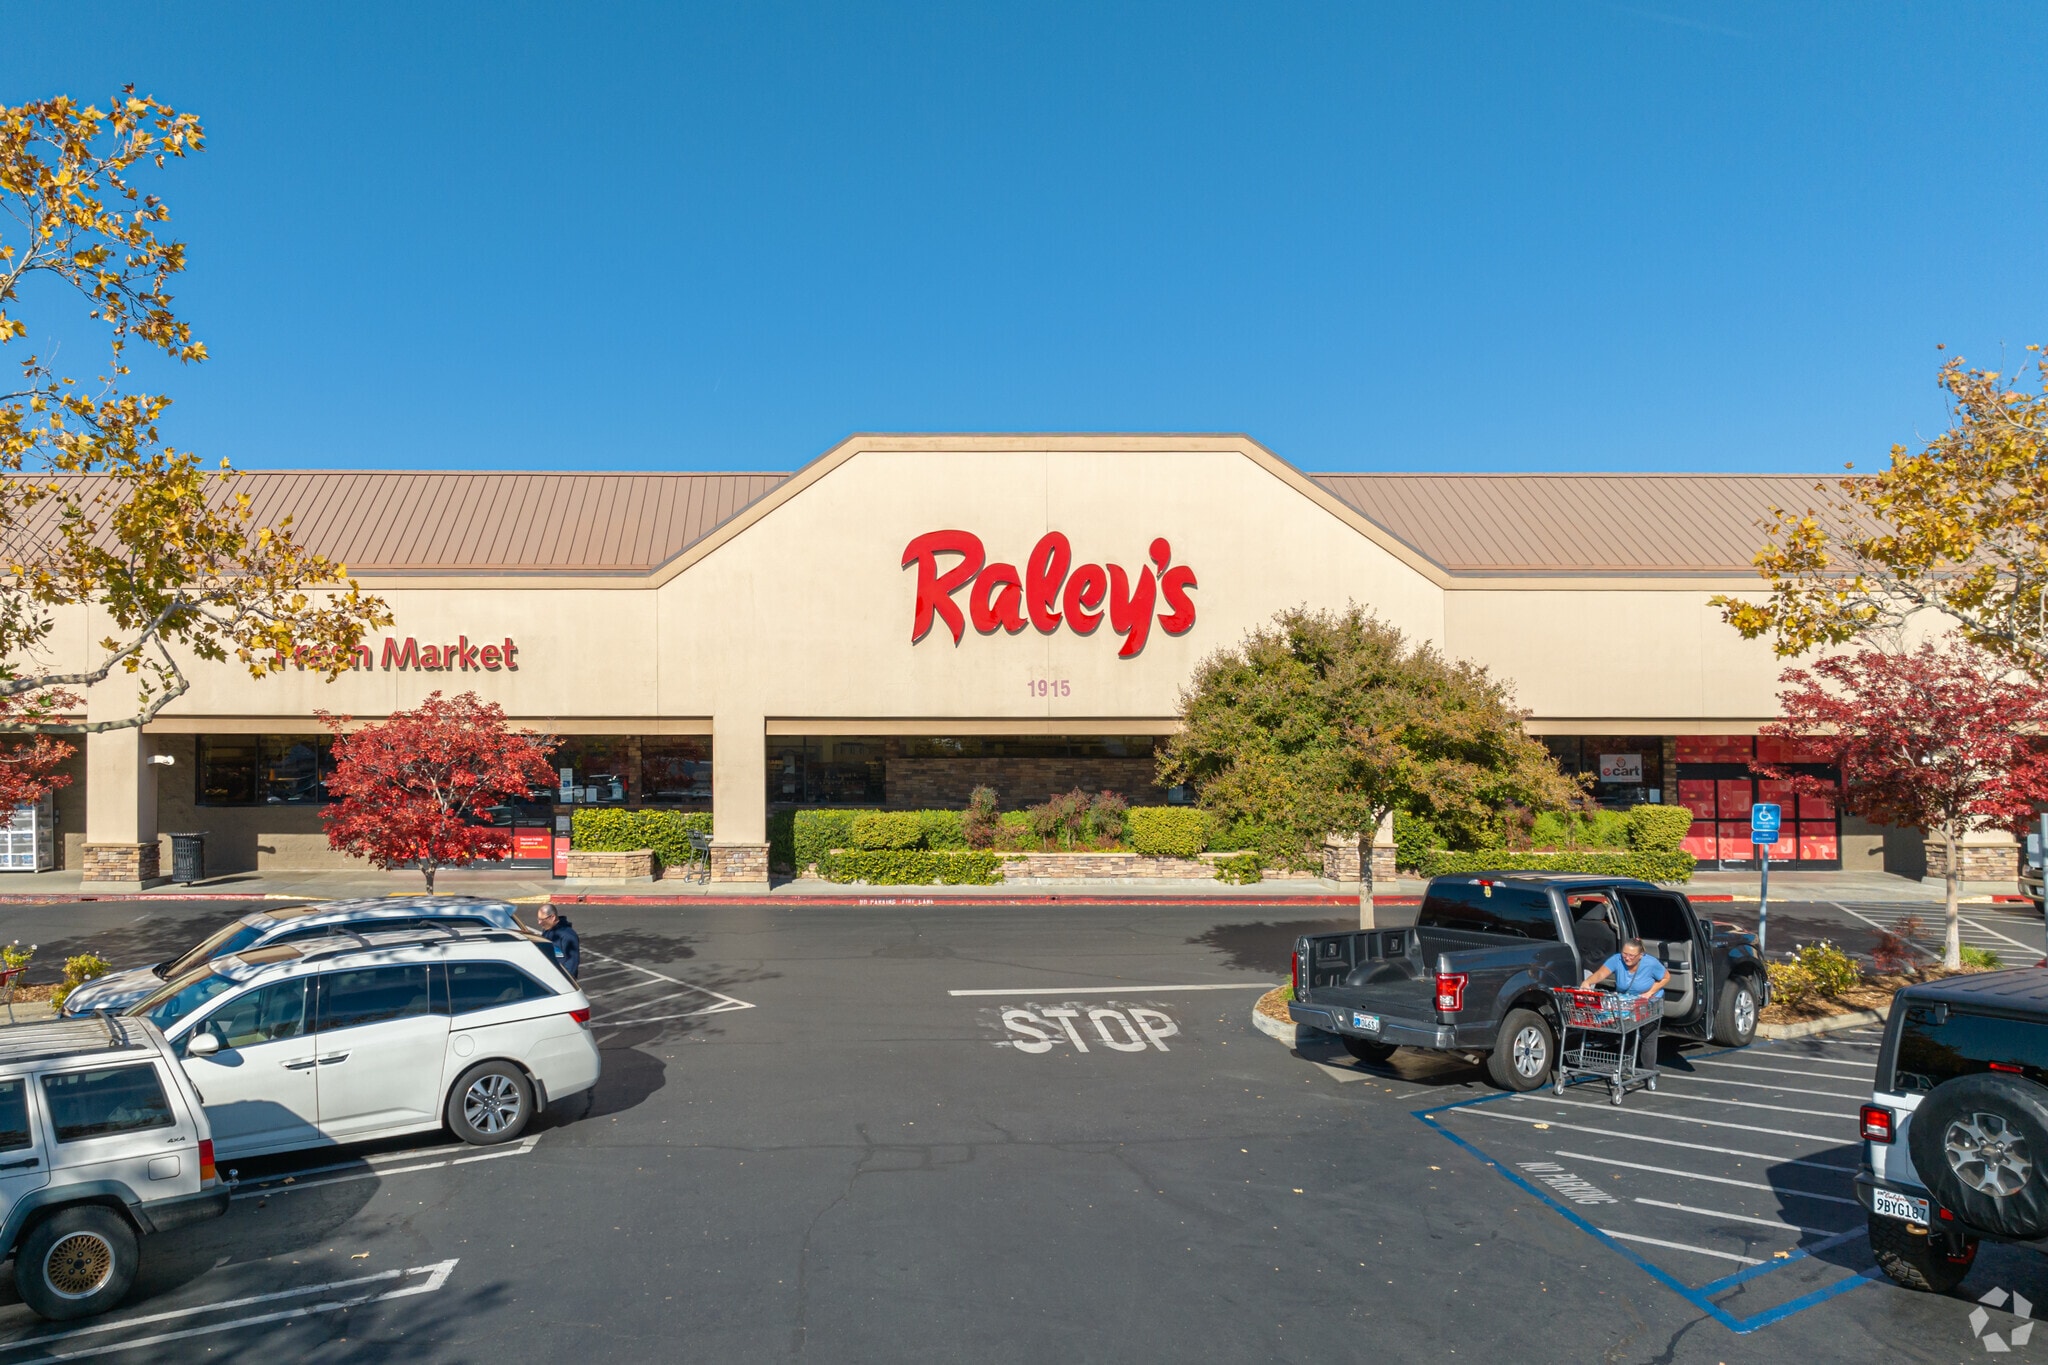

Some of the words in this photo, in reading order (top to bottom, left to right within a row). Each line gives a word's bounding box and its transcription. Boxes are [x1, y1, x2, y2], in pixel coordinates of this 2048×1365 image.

[901, 530, 1198, 657] Raley's
[381, 635, 517, 668] Market
[1027, 679, 1071, 697] 1915
[1001, 1009, 1179, 1054] STOP
[1515, 1162, 1566, 1172] NO
[1534, 1173, 1619, 1205] PARKING
[1877, 1198, 1926, 1220] 9BYG187
